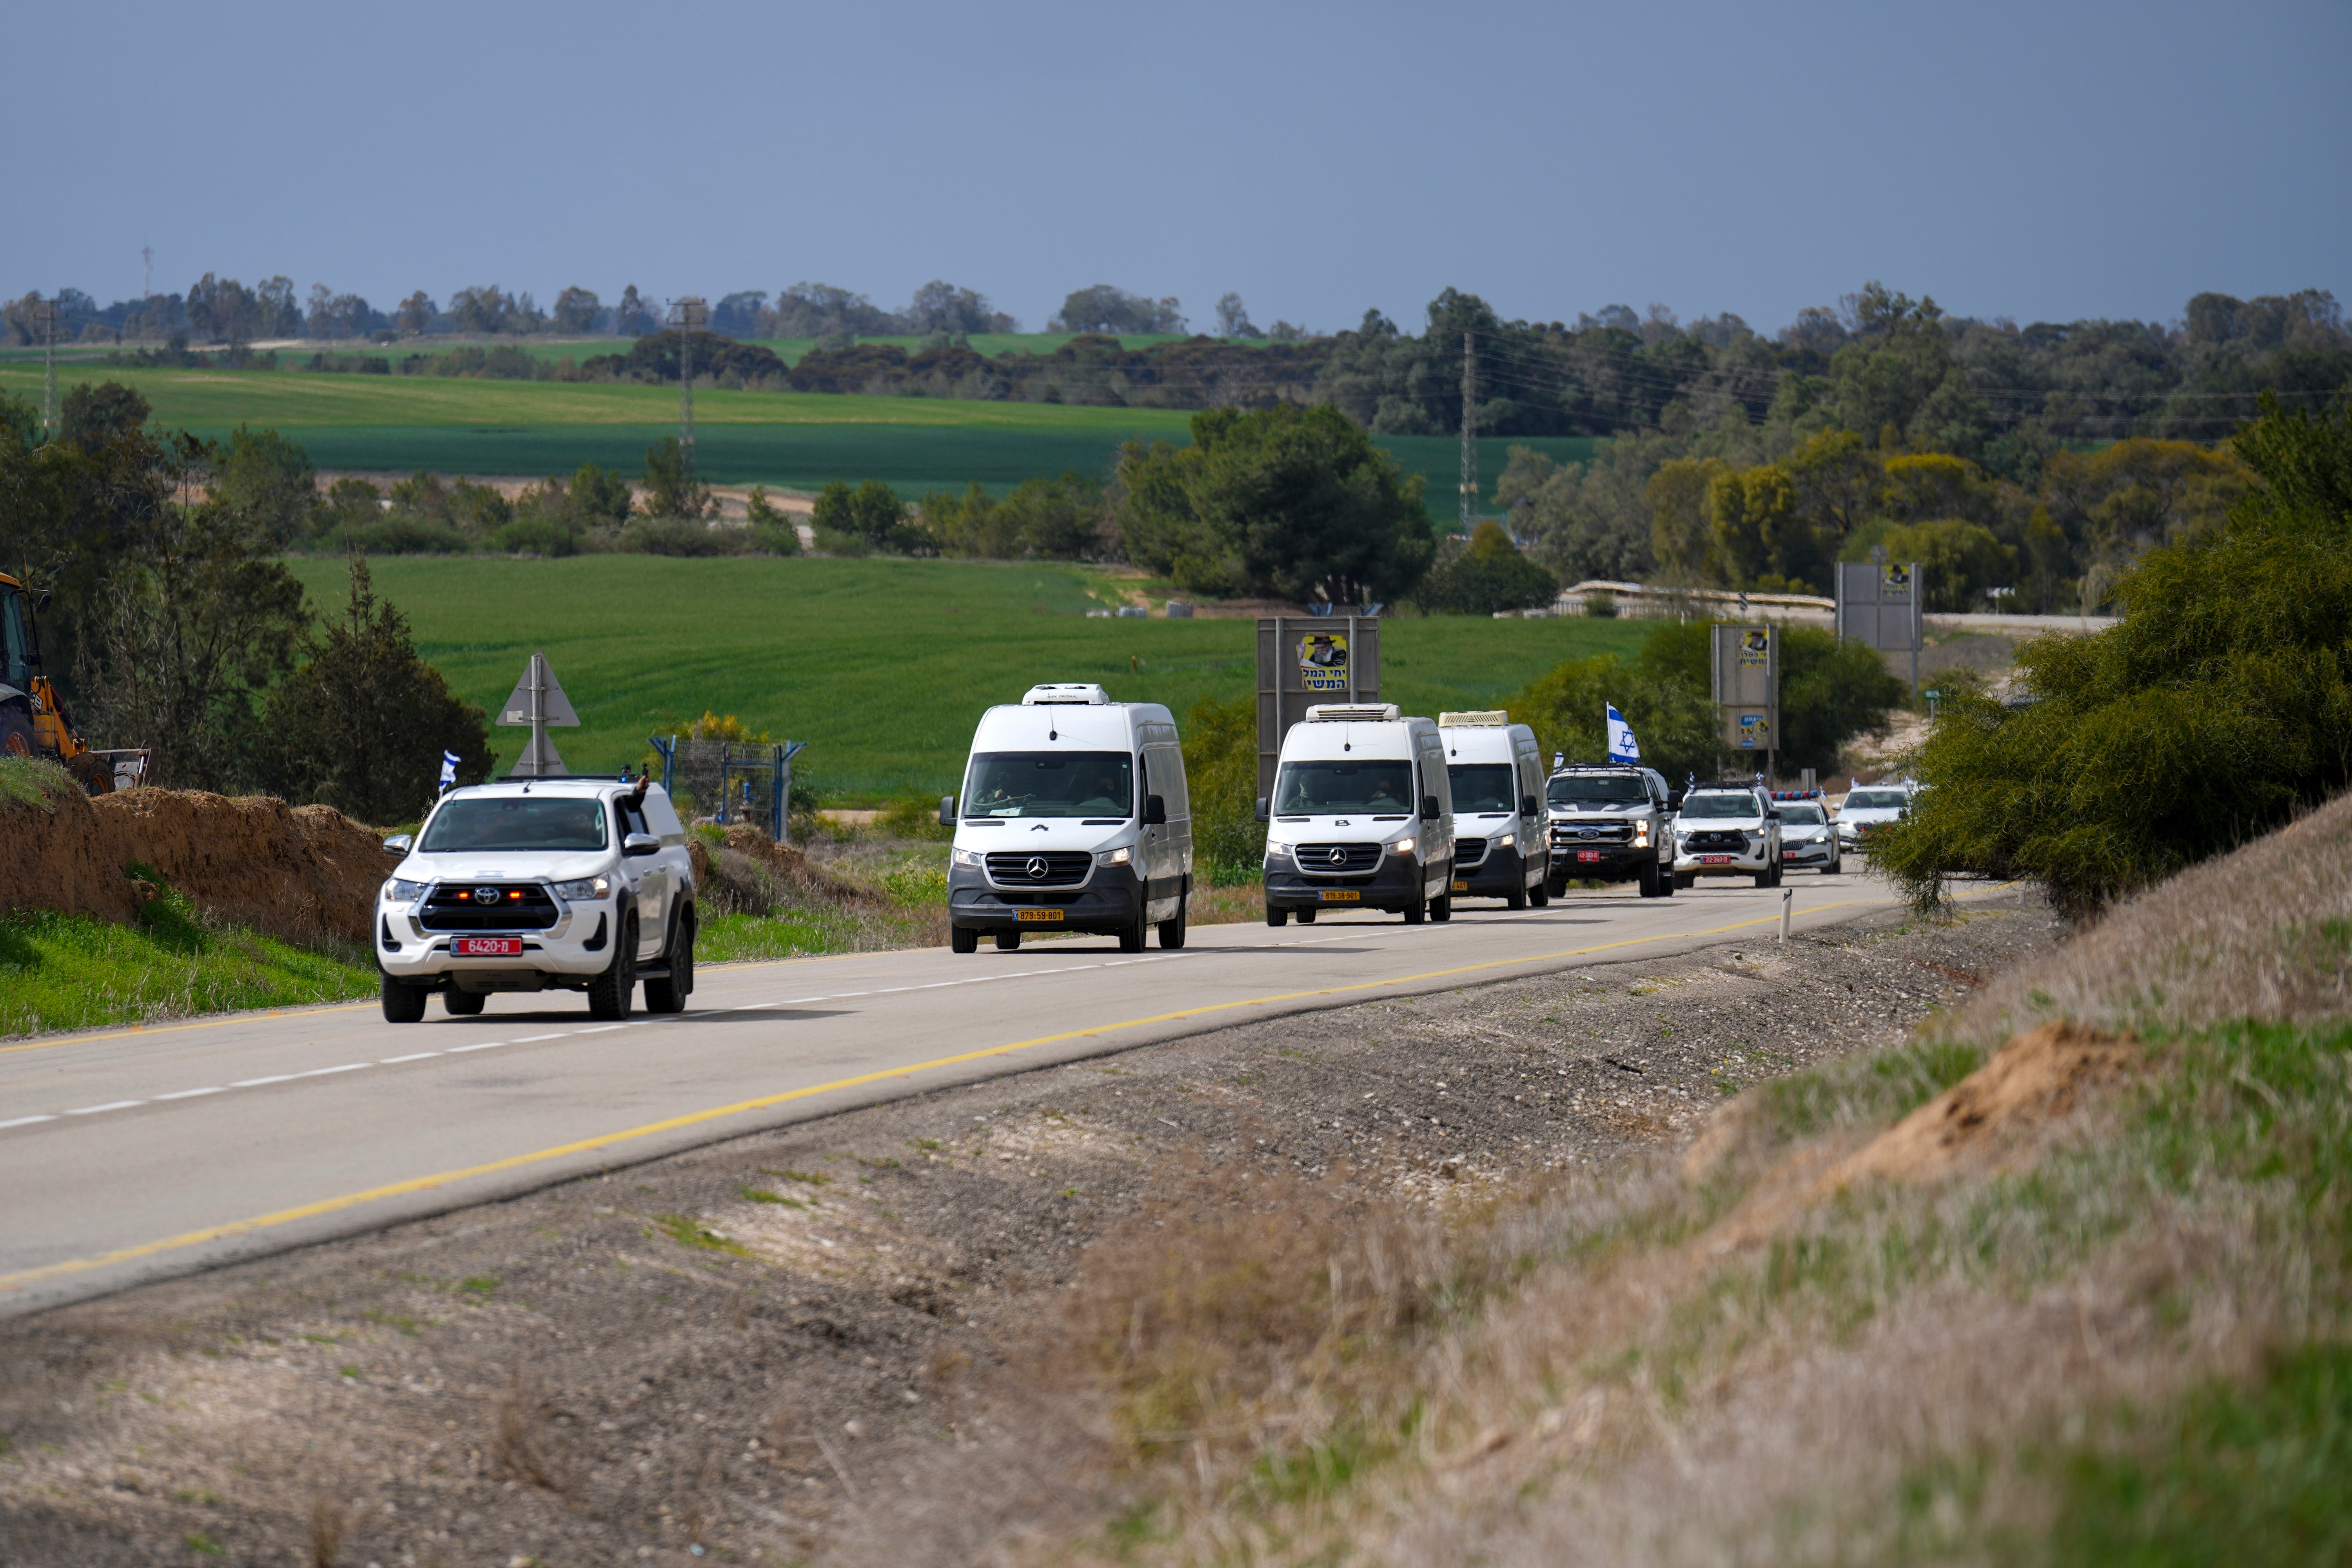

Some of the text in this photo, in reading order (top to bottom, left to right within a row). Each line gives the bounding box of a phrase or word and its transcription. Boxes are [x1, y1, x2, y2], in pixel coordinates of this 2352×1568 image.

[1303, 669, 1325, 677] המל
[1307, 679, 1345, 689] המשי
[1020, 911, 1061, 920] 879-59-801
[468, 940, 508, 952] 6420-מ
